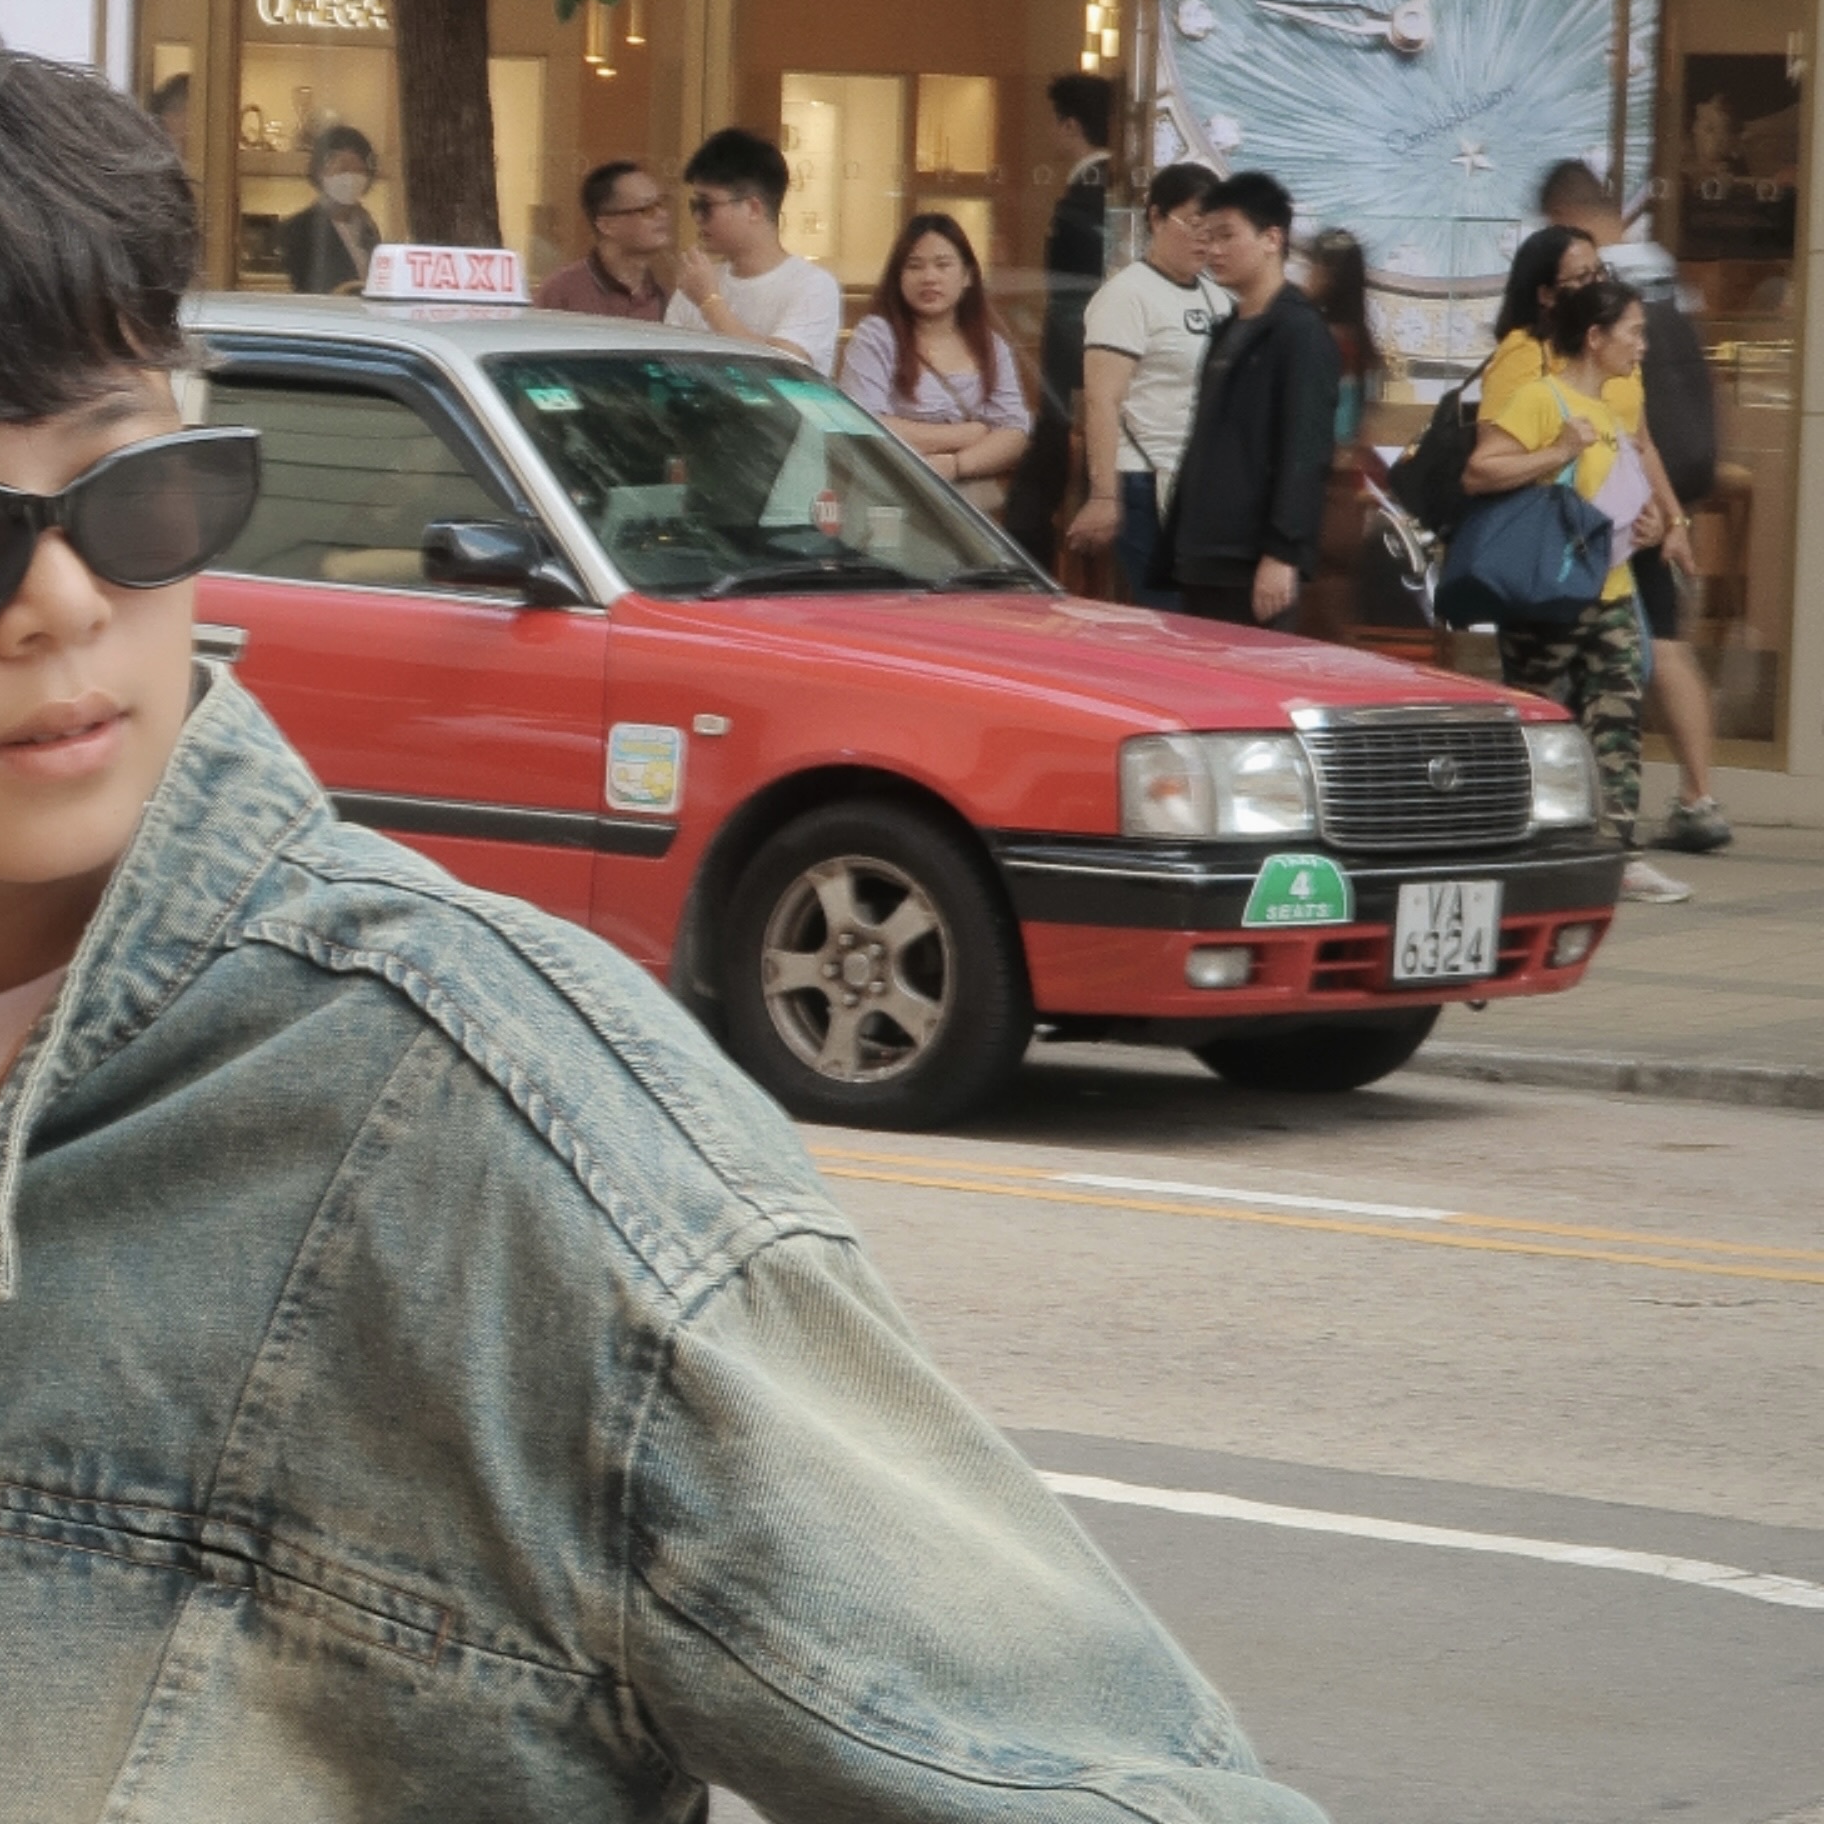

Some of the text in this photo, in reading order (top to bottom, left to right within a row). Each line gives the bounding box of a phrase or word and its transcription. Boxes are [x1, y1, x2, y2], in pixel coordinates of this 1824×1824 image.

[406, 250, 515, 293] TAXI
[1289, 870, 1312, 900] 4
[1428, 884, 1463, 928] VA
[1265, 903, 1328, 920] SEATS
[1401, 929, 1482, 975] 6324
